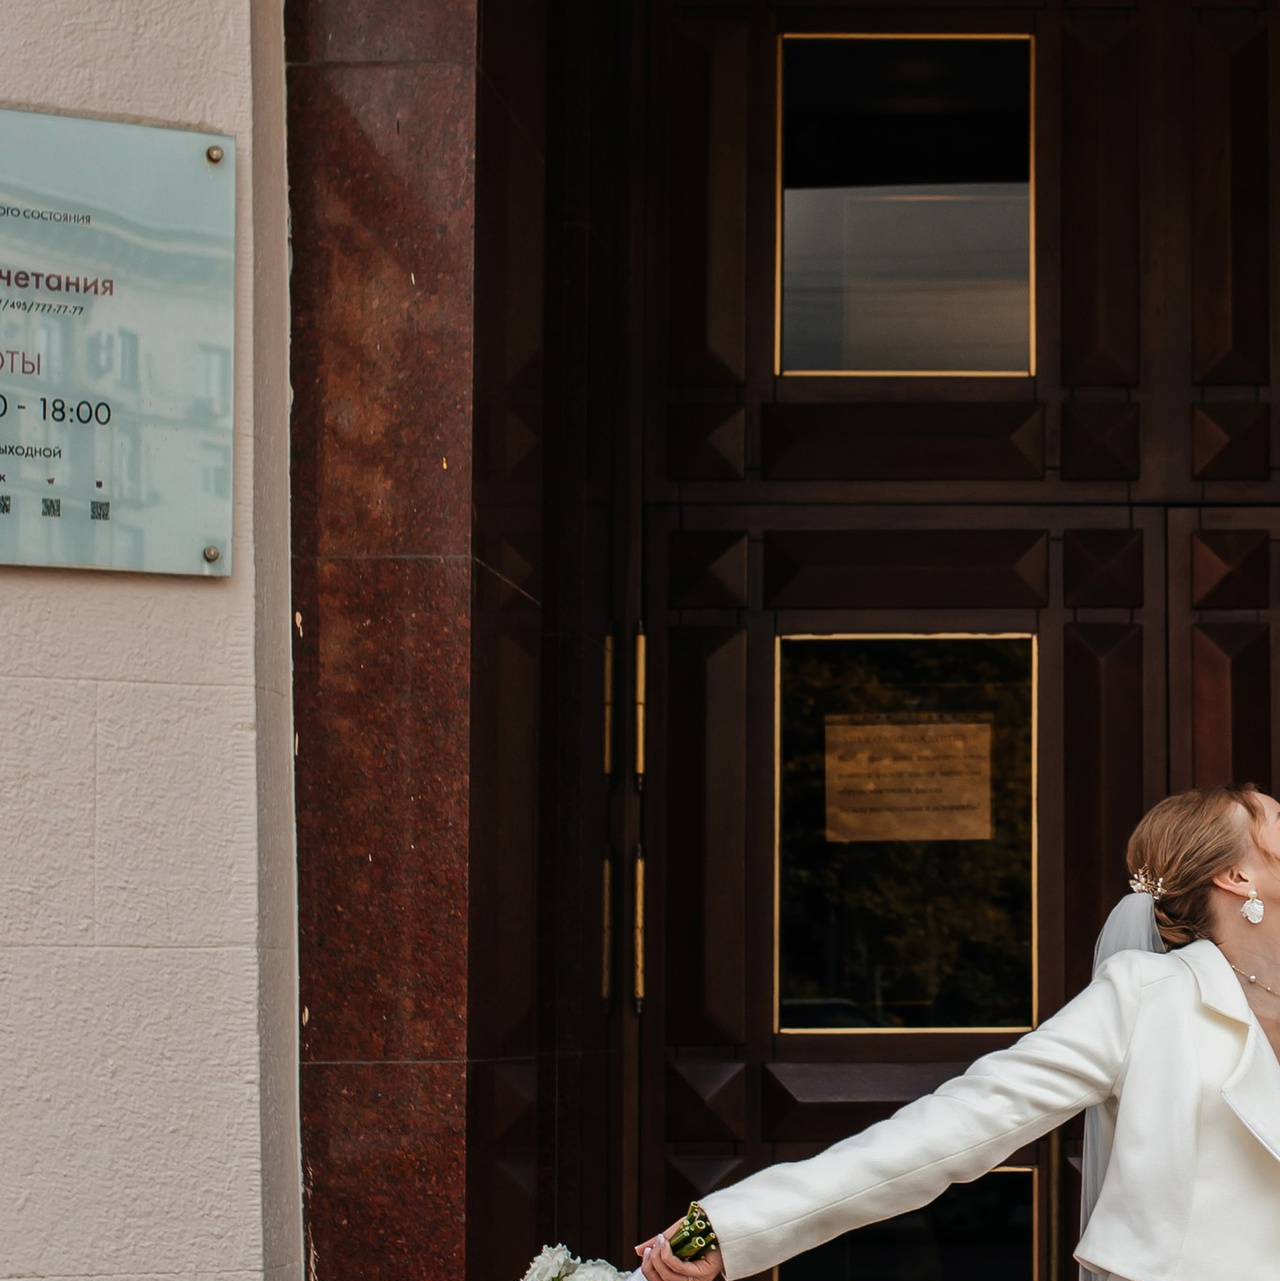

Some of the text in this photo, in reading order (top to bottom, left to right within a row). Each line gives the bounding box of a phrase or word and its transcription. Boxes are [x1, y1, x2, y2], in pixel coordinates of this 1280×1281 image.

[23, 208, 91, 225] состояния
[0, 268, 114, 296] четания
[40, 397, 111, 425] 18:00
